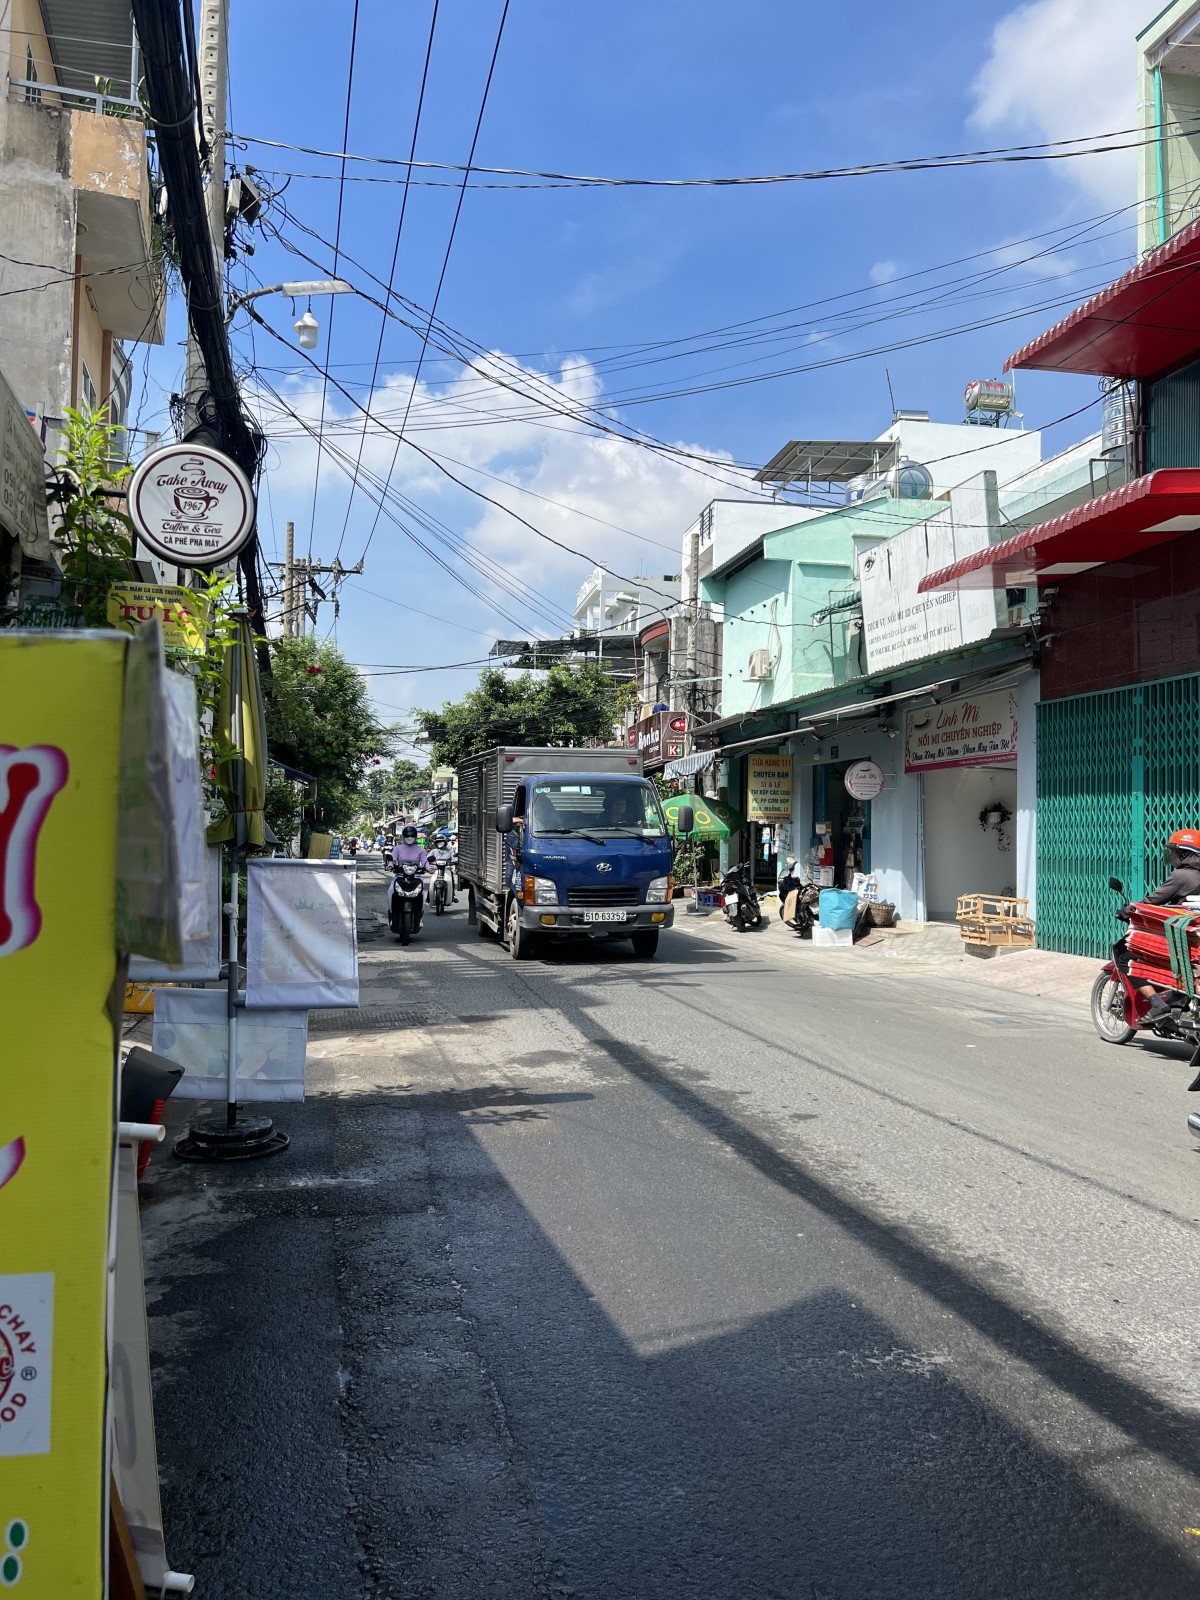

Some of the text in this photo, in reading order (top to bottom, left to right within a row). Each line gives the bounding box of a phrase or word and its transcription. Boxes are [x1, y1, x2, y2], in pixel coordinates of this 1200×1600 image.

[156, 474, 228, 494] Take Away
[183, 501, 203, 511] 1967
[162, 522, 221, 534] Coffee & Tea
[164, 535, 219, 548] CÀ PHÊ PHA MÁY
[936, 702, 980, 730] Linh Mi
[918, 721, 1002, 747] NỐI MI CHUYÊN NGHIỆP
